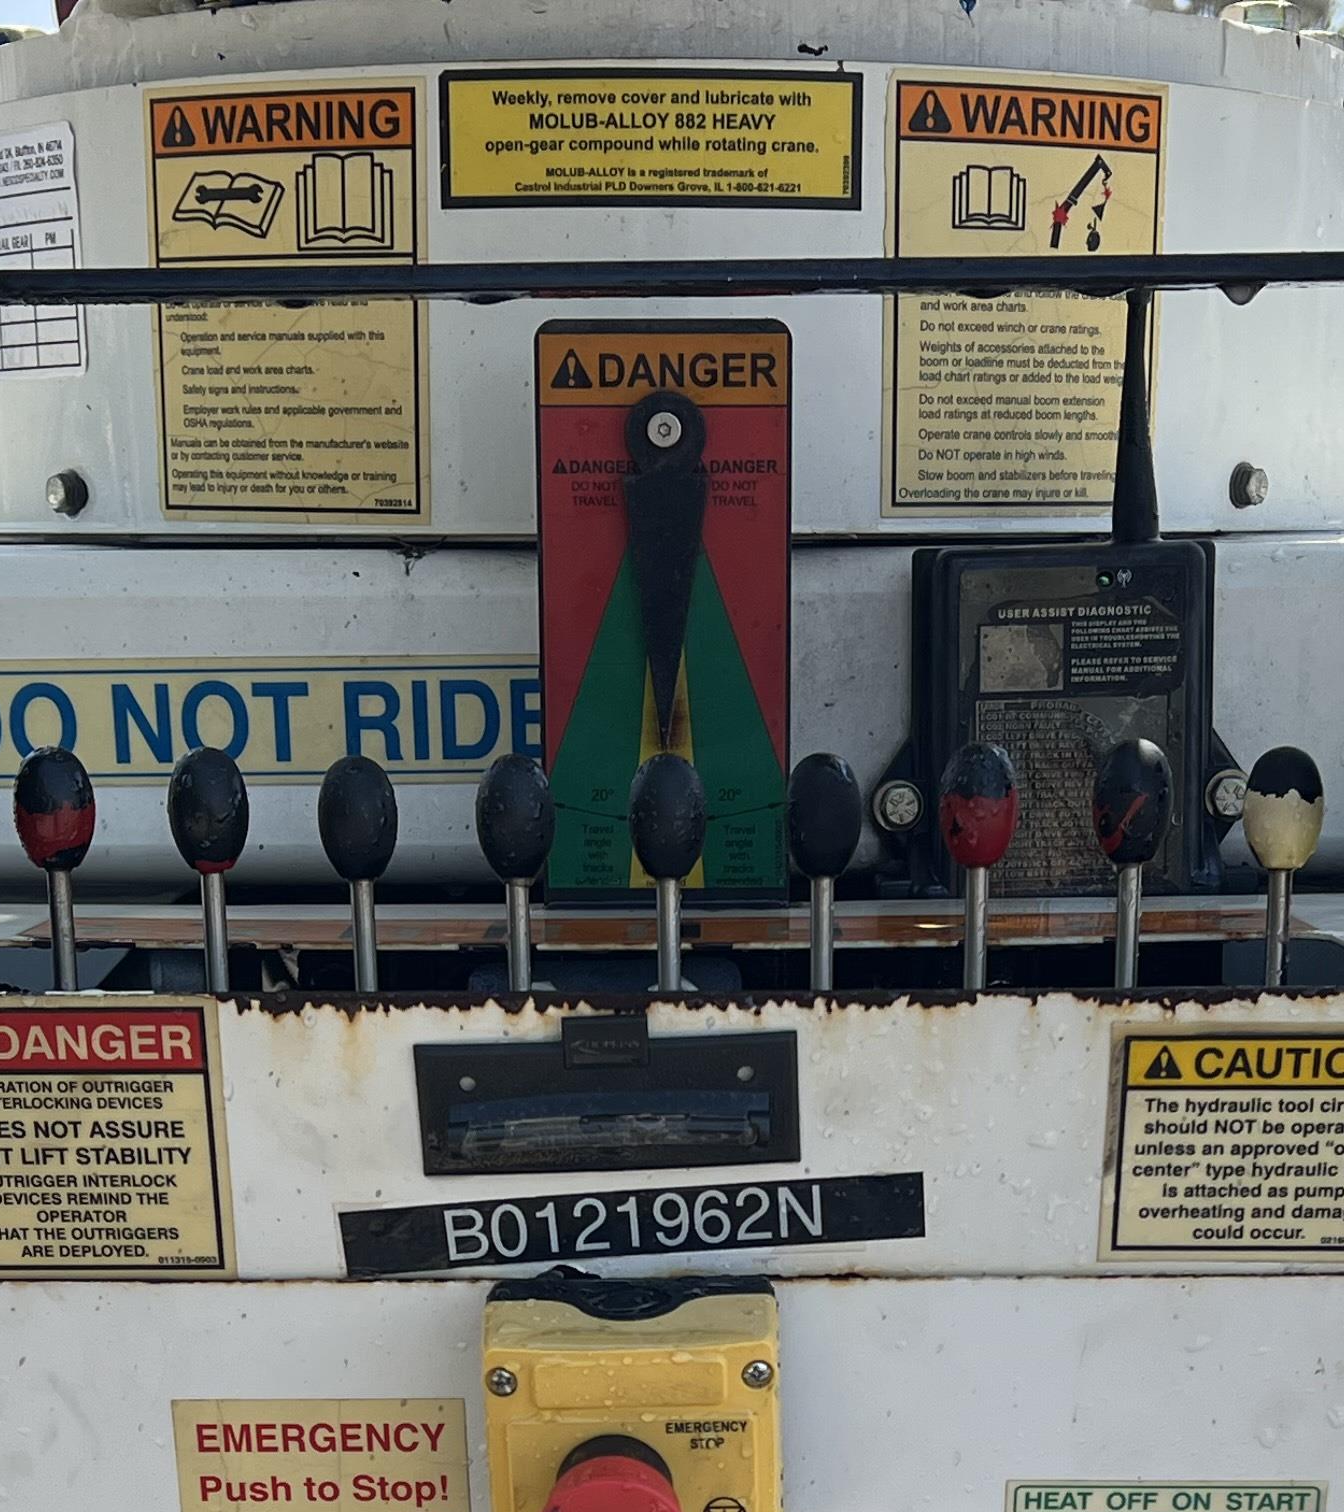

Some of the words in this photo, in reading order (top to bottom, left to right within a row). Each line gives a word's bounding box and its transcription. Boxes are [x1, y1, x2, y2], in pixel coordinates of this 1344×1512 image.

[491, 90, 551, 108] Weekly,
[557, 92, 616, 104] remove
[621, 92, 666, 103] cover
[670, 90, 699, 104] and
[705, 90, 773, 105] lubricate
[778, 91, 811, 106] with
[201, 98, 399, 144] WARNING
[529, 112, 669, 129] MOLUB-ALLOY
[674, 112, 705, 129] 882
[712, 113, 775, 129] HEAVY
[959, 92, 1149, 142] WARNING
[484, 139, 564, 155] open-gear
[568, 135, 653, 154] compound
[658, 135, 700, 151] while
[705, 136, 766, 155] rotating
[771, 141, 818, 152] crane.
[598, 352, 777, 390] DANGER
[998, 608, 1029, 618] USER
[1032, 607, 1075, 617] ASSIST
[1077, 604, 1151, 616] DIAGNOSTIC
[111, 680, 308, 764] NOT
[343, 679, 540, 761] RIDE
[1144, 1098, 1178, 1112] The
[1185, 1097, 1271, 1116] hydraulic
[1278, 1097, 1314, 1112] tool
[33, 1120, 81, 1138] NOT
[89, 1120, 184, 1138] ASSURE
[1144, 1119, 1207, 1134] should
[1214, 1118, 1257, 1134] NOT
[1261, 1119, 1284, 1134] be
[20, 1147, 68, 1165] LIFT
[75, 1145, 190, 1165] STABILITY
[443, 1184, 822, 1260] B0121962N
[196, 1422, 445, 1452] EMERGENCY
[665, 1420, 747, 1434] EMERGENCY
[689, 1436, 724, 1449] STOP
[199, 1475, 291, 1501] Push
[303, 1477, 339, 1501] to
[352, 1474, 448, 1507] Stop!
[1024, 1491, 1093, 1510] HEAT
[1106, 1491, 1158, 1510] OFF
[1171, 1492, 1211, 1510] ON
[1225, 1492, 1311, 1511] START
